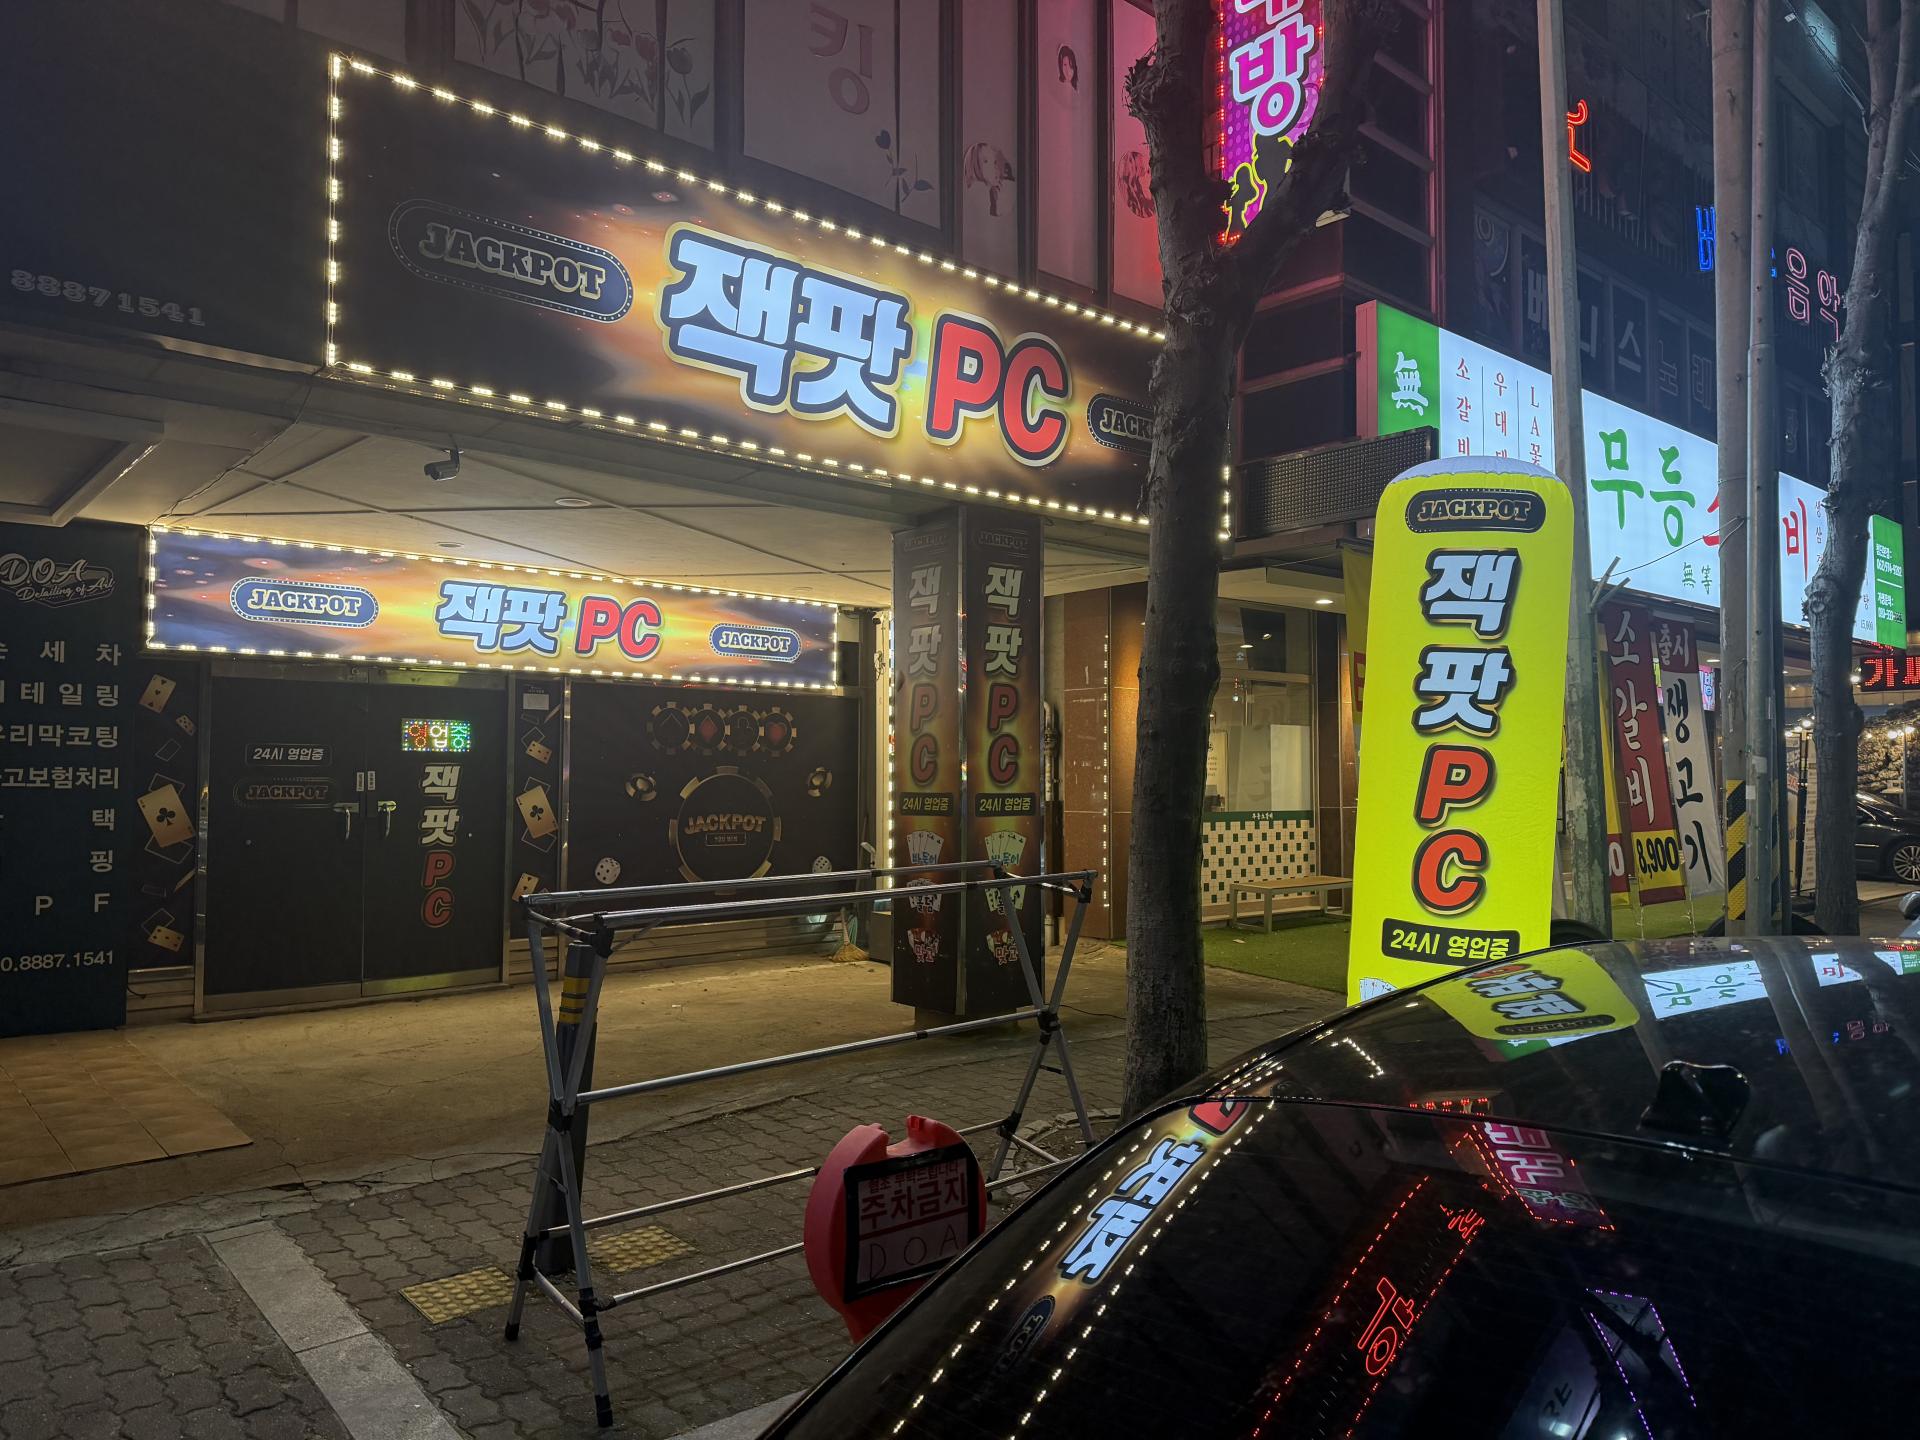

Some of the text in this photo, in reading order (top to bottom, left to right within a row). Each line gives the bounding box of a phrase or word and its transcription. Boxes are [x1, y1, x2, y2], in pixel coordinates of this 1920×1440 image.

[1230, 0, 1315, 136] 방
[419, 222, 606, 300] JACKPOT
[663, 231, 1069, 459] 잭팟 PC
[1456, 358, 1471, 457] 소갈비
[1417, 498, 1531, 523] JACKPOT
[1591, 429, 1695, 547] 무등
[247, 588, 361, 617] JACKPOT
[437, 580, 661, 658] 잭팟 PC
[908, 565, 942, 675] 잭팟
[985, 566, 1024, 675] 잭팟
[719, 631, 792, 654] JACKPOT
[1416, 550, 1520, 737] 잭팟
[1658, 623, 1689, 668] 출시
[0, 724, 119, 748] 리막코팅
[253, 748, 324, 761] 24시 영업중
[408, 724, 465, 749] 영업중
[911, 684, 938, 785] PC
[989, 684, 1019, 785] PC
[1611, 611, 1654, 825] 소갈비
[0, 767, 119, 790] 고보험처리
[247, 784, 328, 800] JACKPOT
[421, 765, 461, 845] 잭팟
[902, 797, 949, 811] 24시 영업중
[979, 798, 1031, 812] 24시 영업중
[1667, 678, 1712, 884] 생고기
[684, 814, 767, 835] JACKPOT
[1416, 746, 1495, 911] PC
[1637, 837, 1679, 878] 8,900
[421, 851, 455, 926] PC
[1390, 929, 1510, 960] 24시 영업중
[860, 1172, 967, 1230] 주차금지
